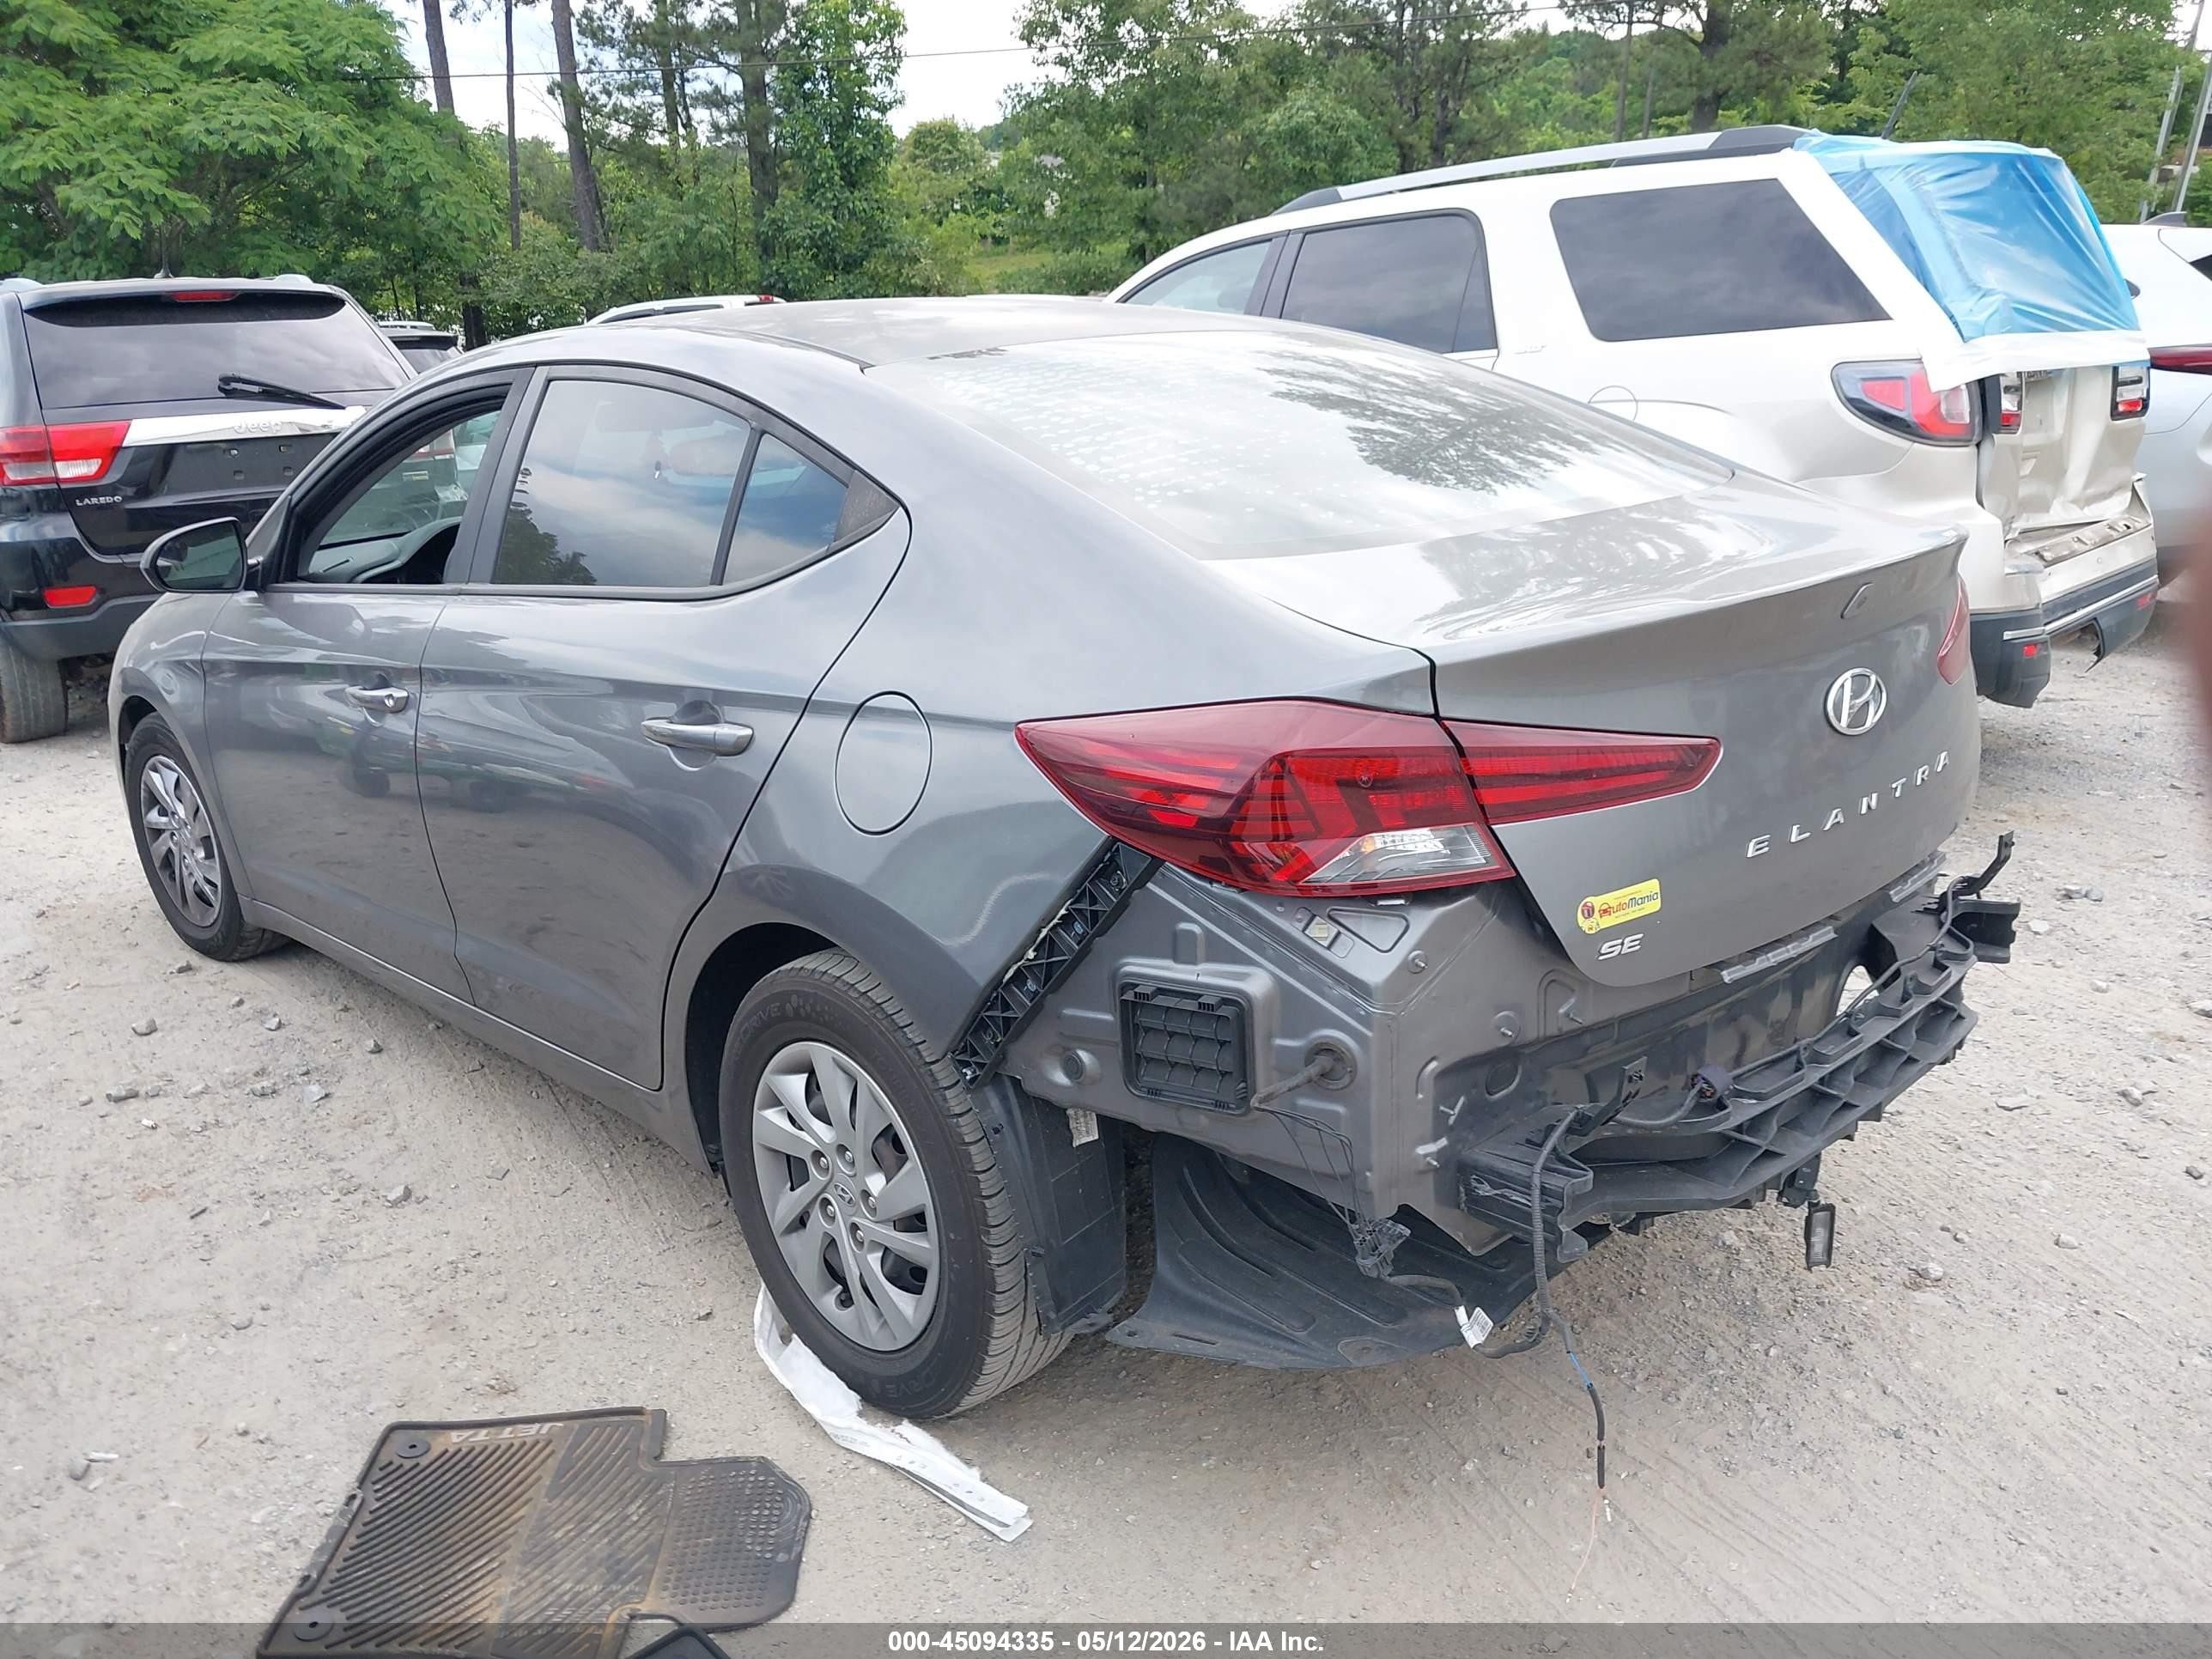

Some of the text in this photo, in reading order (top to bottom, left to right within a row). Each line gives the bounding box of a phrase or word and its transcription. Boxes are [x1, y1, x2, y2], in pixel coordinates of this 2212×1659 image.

[233, 419, 283, 434] Jeep
[75, 495, 122, 507] LAREDO
[1746, 750, 1950, 858] ELANTRA
[1598, 933, 1644, 960] SE
[450, 1422, 564, 1443] JETTA
